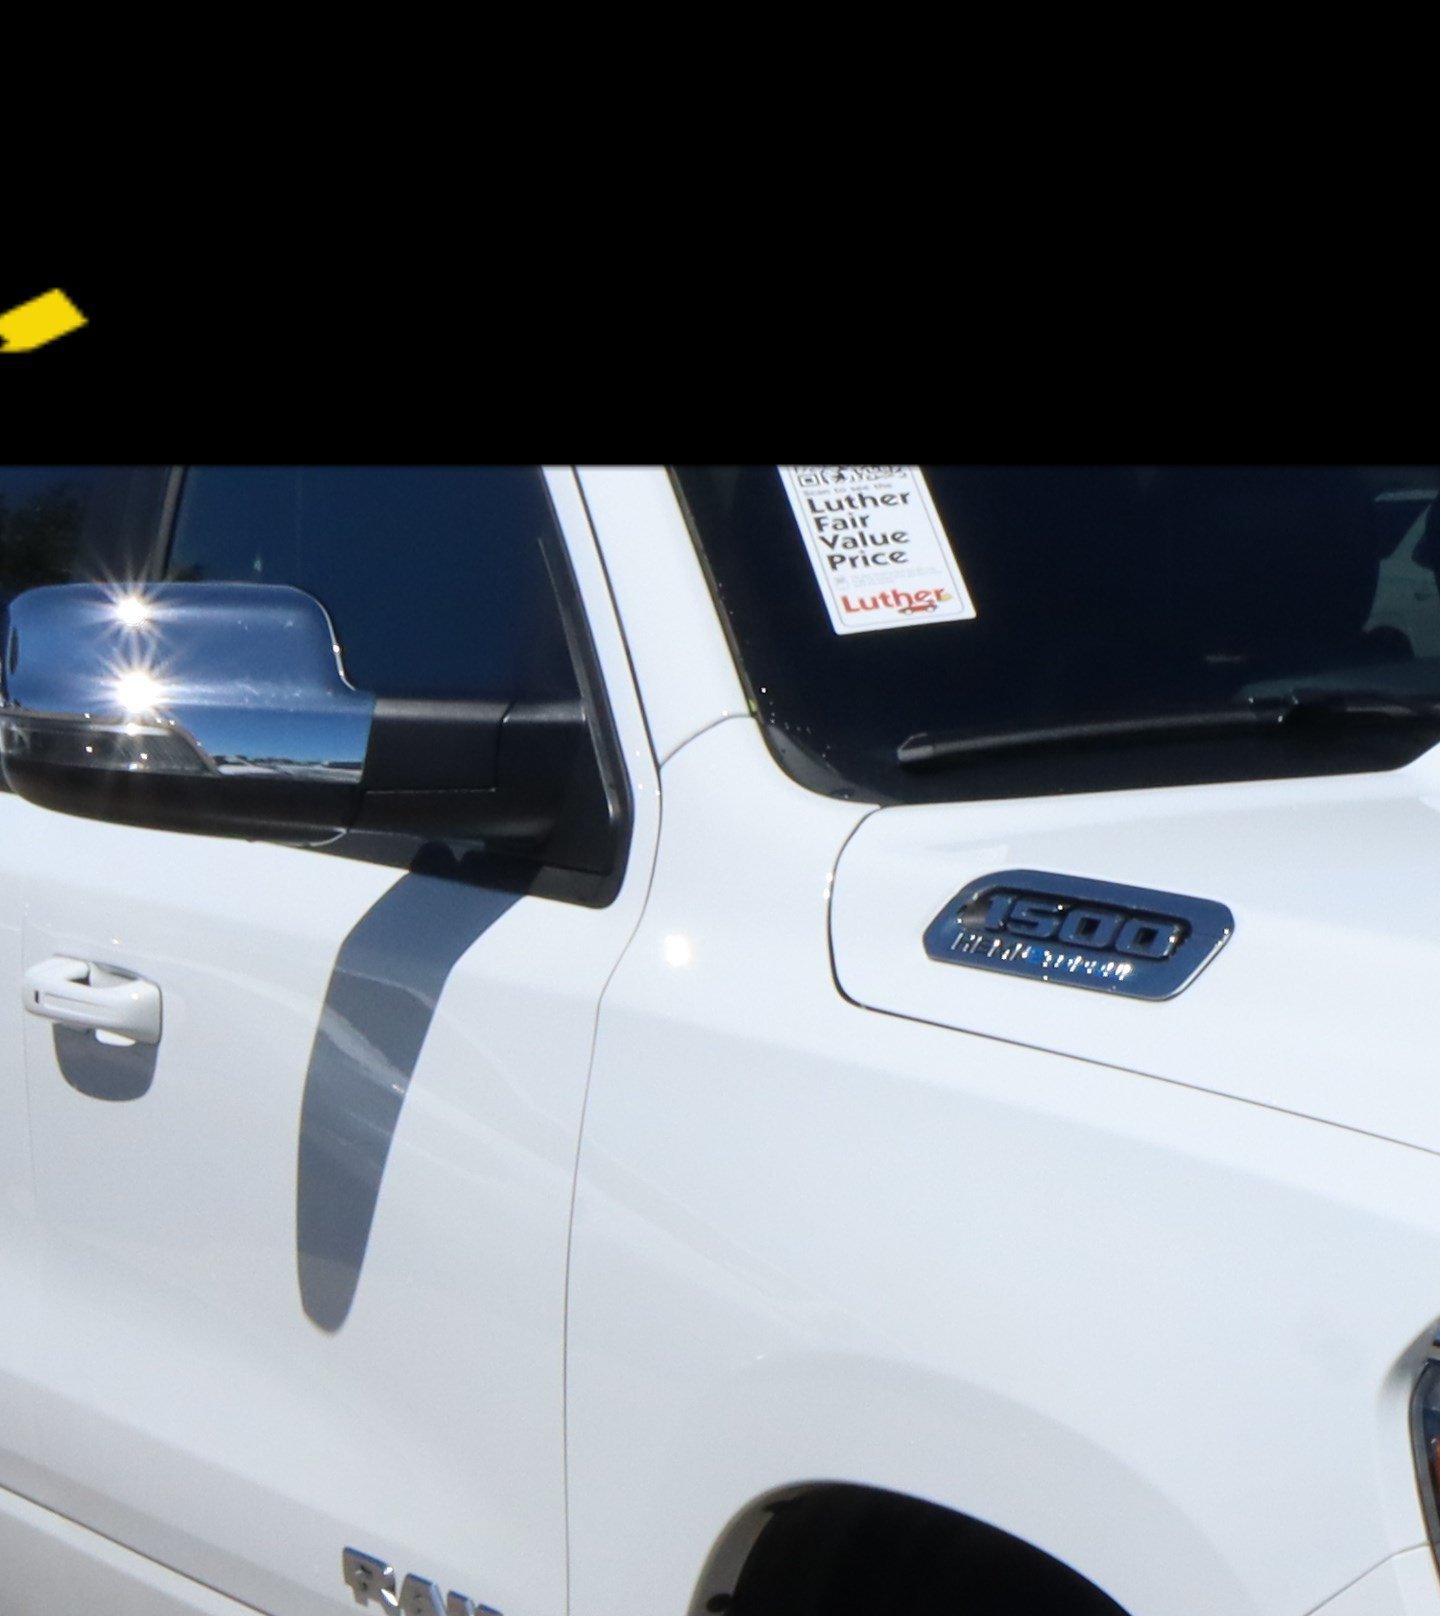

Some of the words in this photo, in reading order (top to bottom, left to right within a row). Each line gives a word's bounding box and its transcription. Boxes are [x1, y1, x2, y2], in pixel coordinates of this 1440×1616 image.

[806, 492, 910, 514] Luther
[813, 512, 870, 533] Fair
[818, 530, 910, 551] Value
[826, 549, 910, 571] Price
[840, 588, 945, 614] Luther
[982, 893, 1182, 960] 1500
